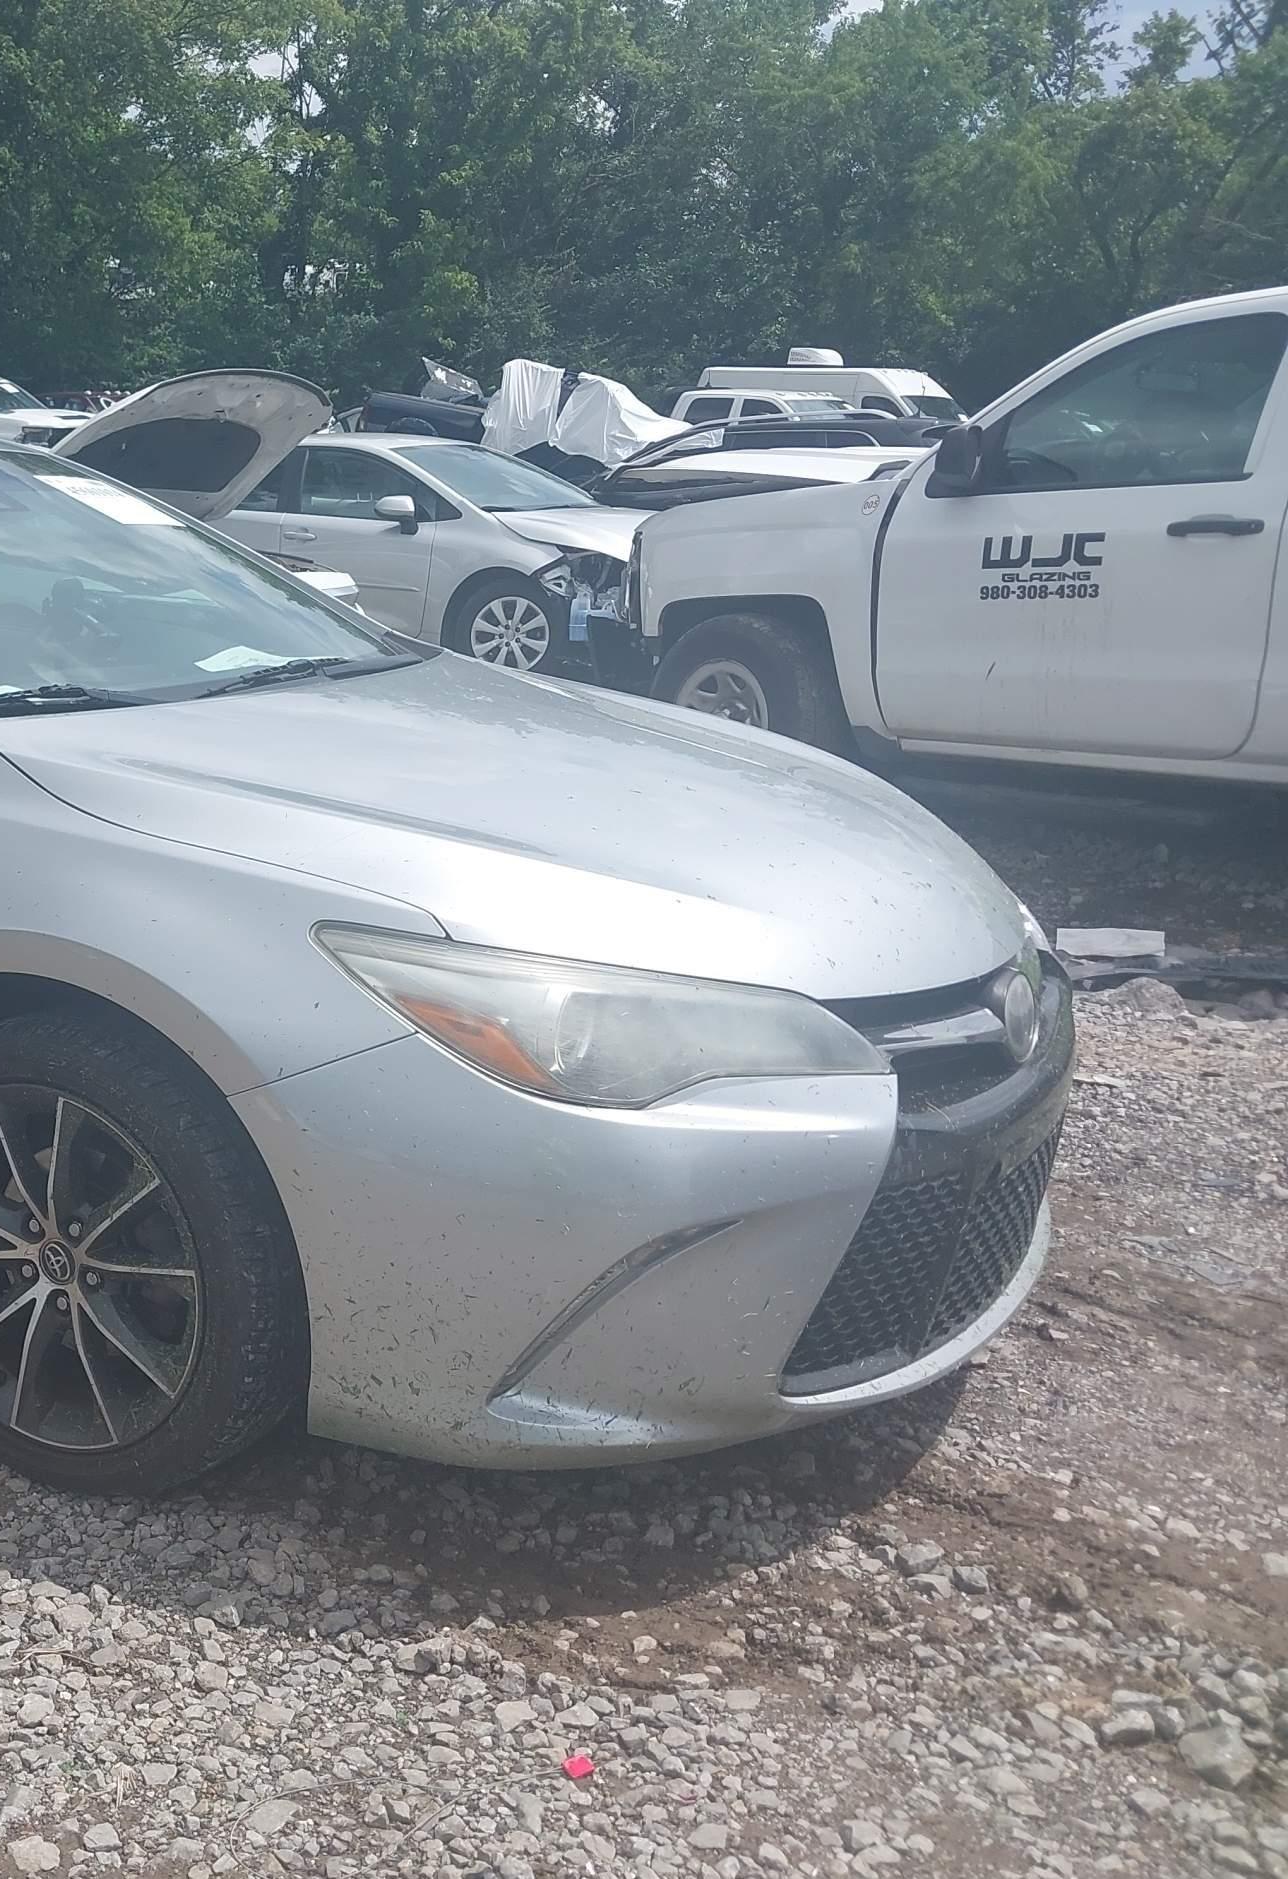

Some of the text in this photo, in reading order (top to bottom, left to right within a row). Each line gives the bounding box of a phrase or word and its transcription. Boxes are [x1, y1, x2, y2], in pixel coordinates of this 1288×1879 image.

[981, 532, 1106, 569] WJC
[1001, 571, 1091, 583] GLAZING
[979, 583, 1100, 600] 980-308-4303
